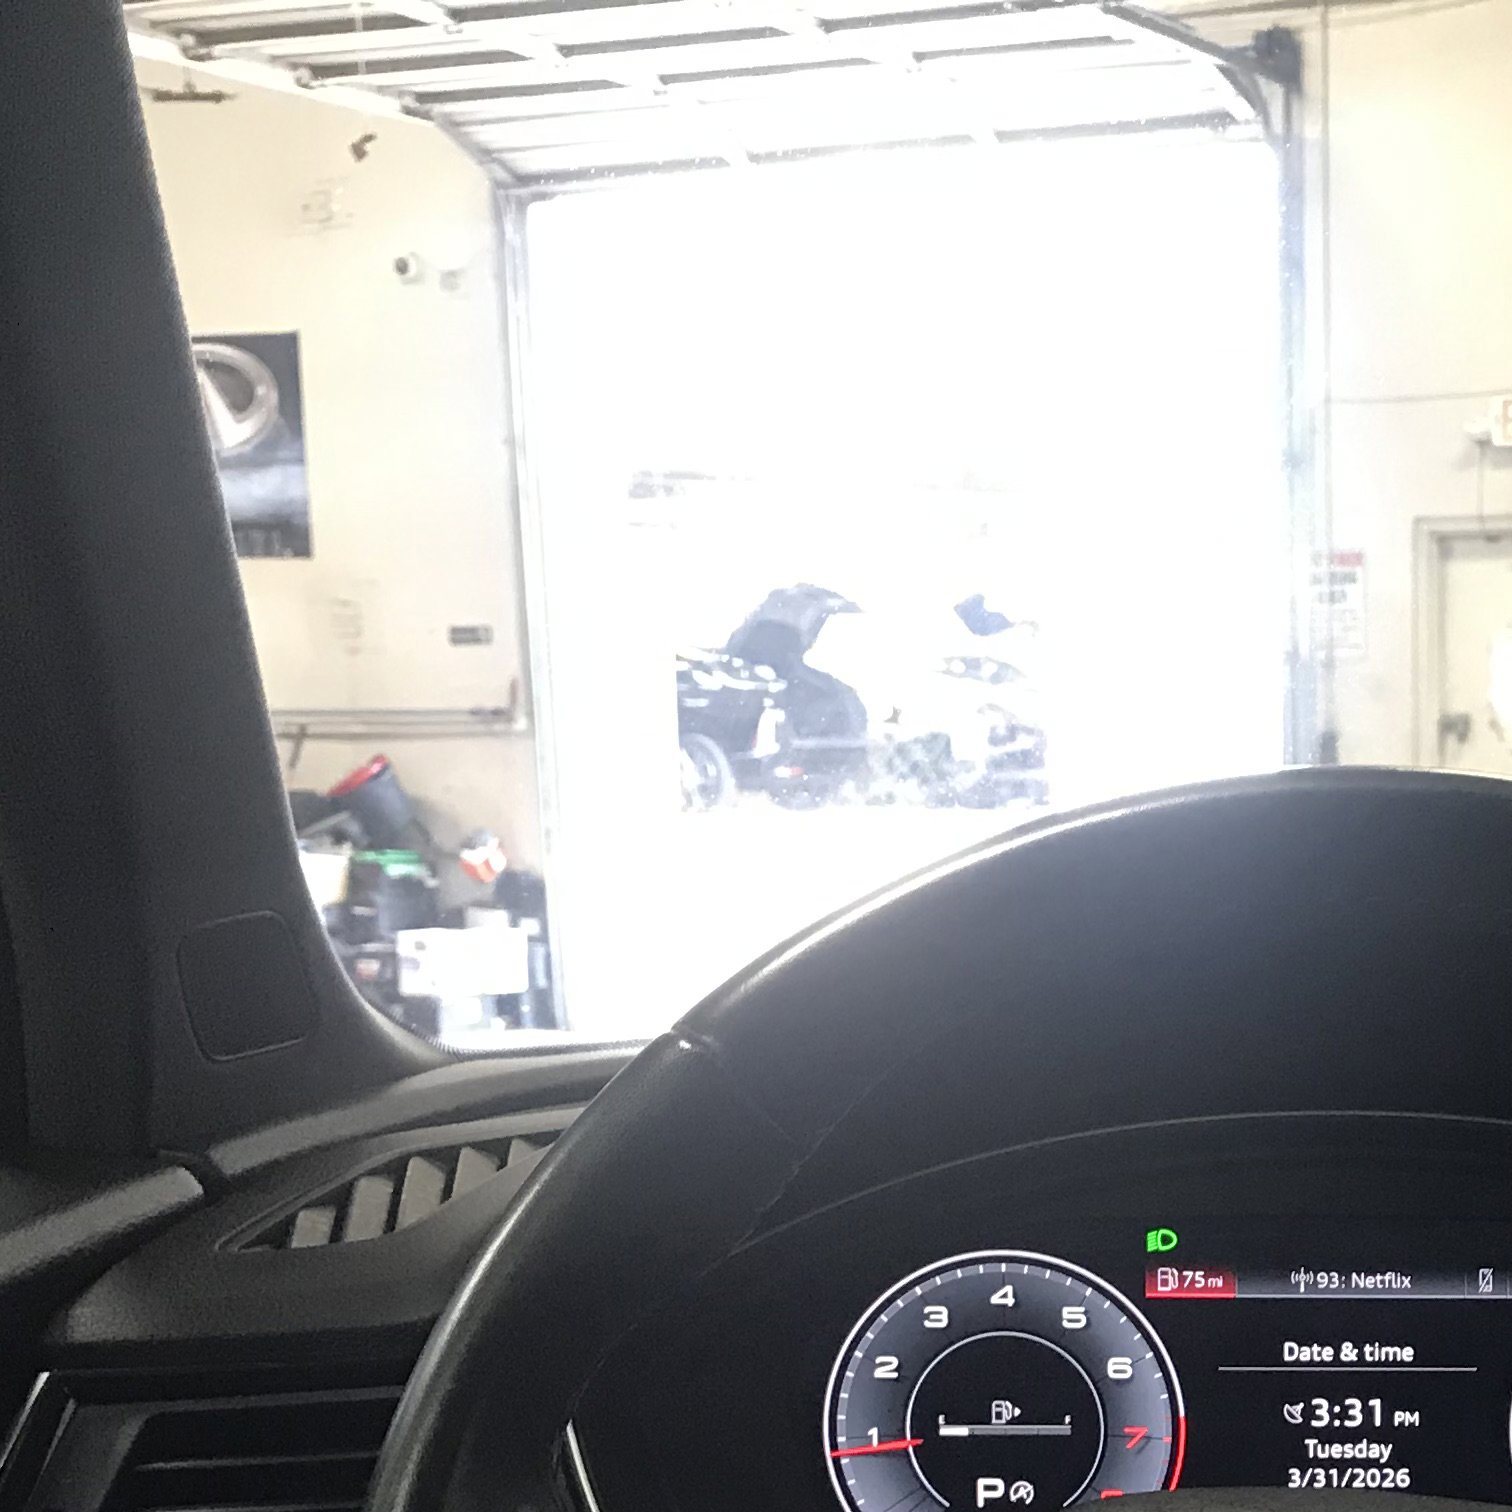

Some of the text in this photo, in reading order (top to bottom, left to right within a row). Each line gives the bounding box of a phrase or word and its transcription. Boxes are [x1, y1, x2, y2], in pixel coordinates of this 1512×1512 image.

[1182, 1271, 1223, 1289] 75 mi
[1317, 1271, 1411, 1289] 93: Netflix
[990, 1285, 1015, 1307] 4
[923, 1306, 949, 1328] 3
[1062, 1307, 1087, 1328] 5
[1283, 1342, 1414, 1362] Date & time
[874, 1356, 899, 1379] 2
[1107, 1357, 1133, 1379] 6
[1310, 1398, 1420, 1427] 3:31 PM
[867, 1427, 879, 1448] 1
[1123, 1427, 1149, 1449] 7
[1304, 1439, 1392, 1463] Tuesday
[1287, 1468, 1411, 1489] 3/31/2026
[976, 1478, 1005, 1508] P
